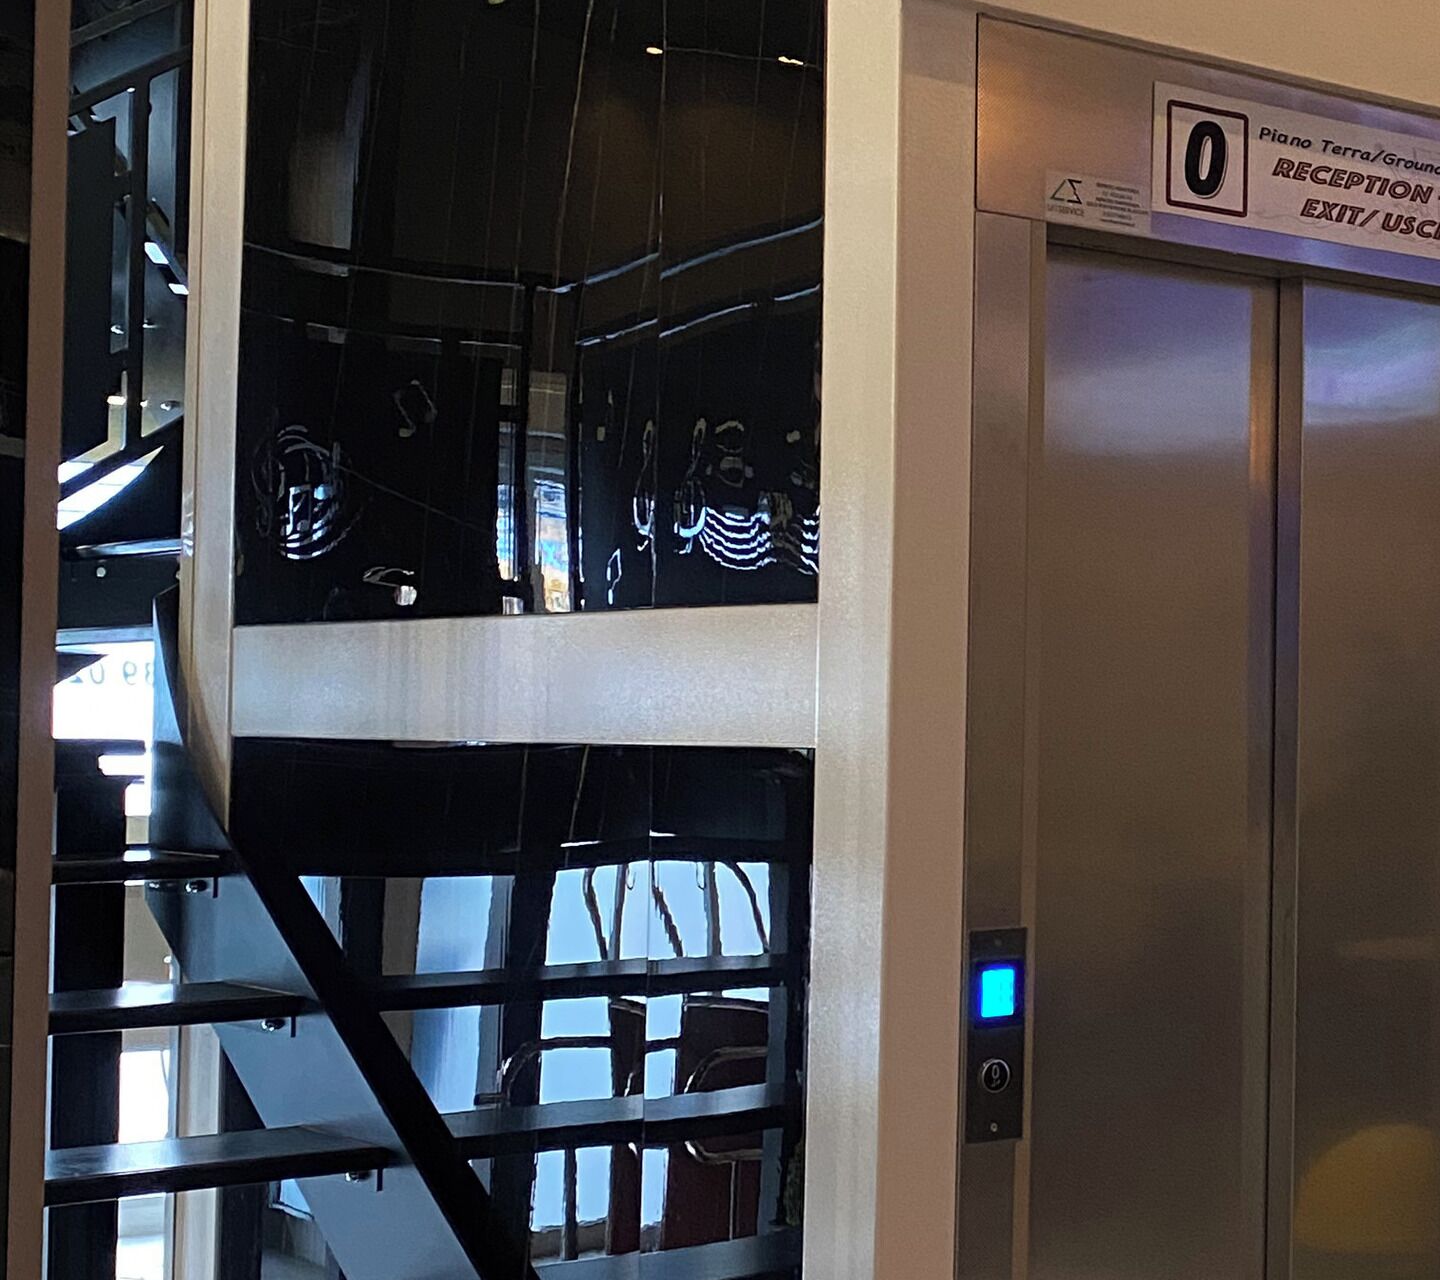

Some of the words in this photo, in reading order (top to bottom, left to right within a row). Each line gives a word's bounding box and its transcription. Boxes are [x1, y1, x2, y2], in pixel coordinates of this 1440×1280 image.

[1258, 126, 1312, 150] Piano
[1184, 120, 1230, 200] 0
[1271, 157, 1434, 204] RECEPTION
[1300, 198, 1380, 228] EXIT/
